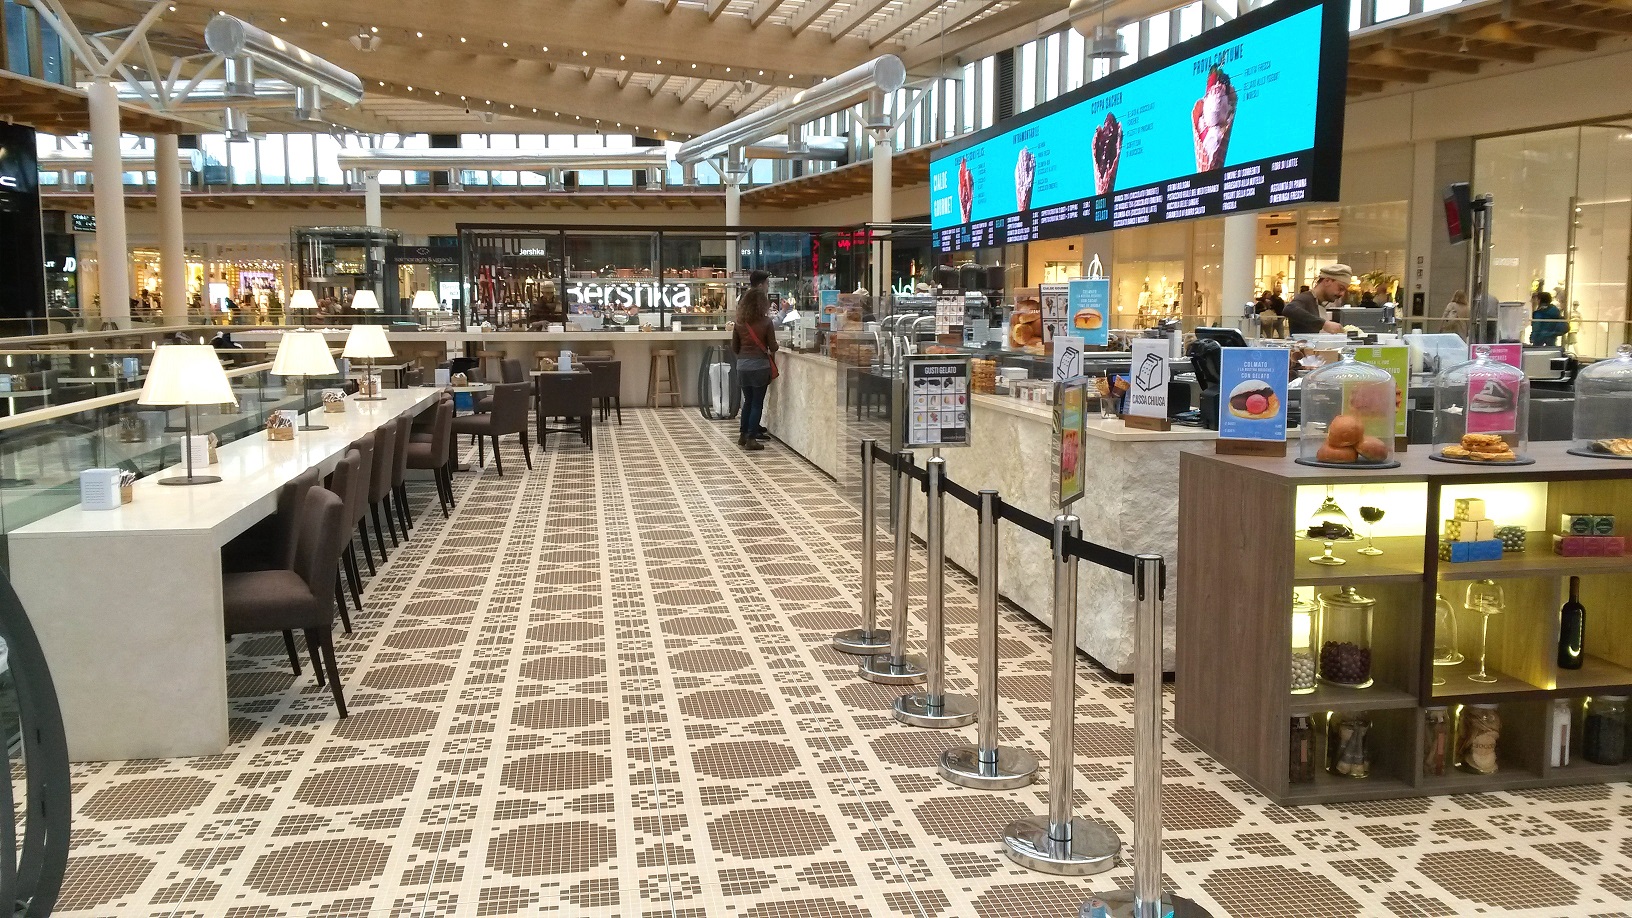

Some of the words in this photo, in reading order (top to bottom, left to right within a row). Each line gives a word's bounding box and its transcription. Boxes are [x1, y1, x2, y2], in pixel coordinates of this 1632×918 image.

[1193, 57, 1212, 76] PROVA
[1213, 43, 1243, 66] COSTUME
[1091, 98, 1105, 115] COPPA
[934, 171, 948, 192] CIALDE
[934, 196, 953, 217] GOURMET
[741, 248, 763, 256] ersa
[63, 256, 77, 272] JD
[924, 366, 939, 375] GUSTI
[939, 366, 957, 374] GELATO
[1132, 394, 1147, 405] CASSA
[1147, 395, 1166, 407] CHIUSA
